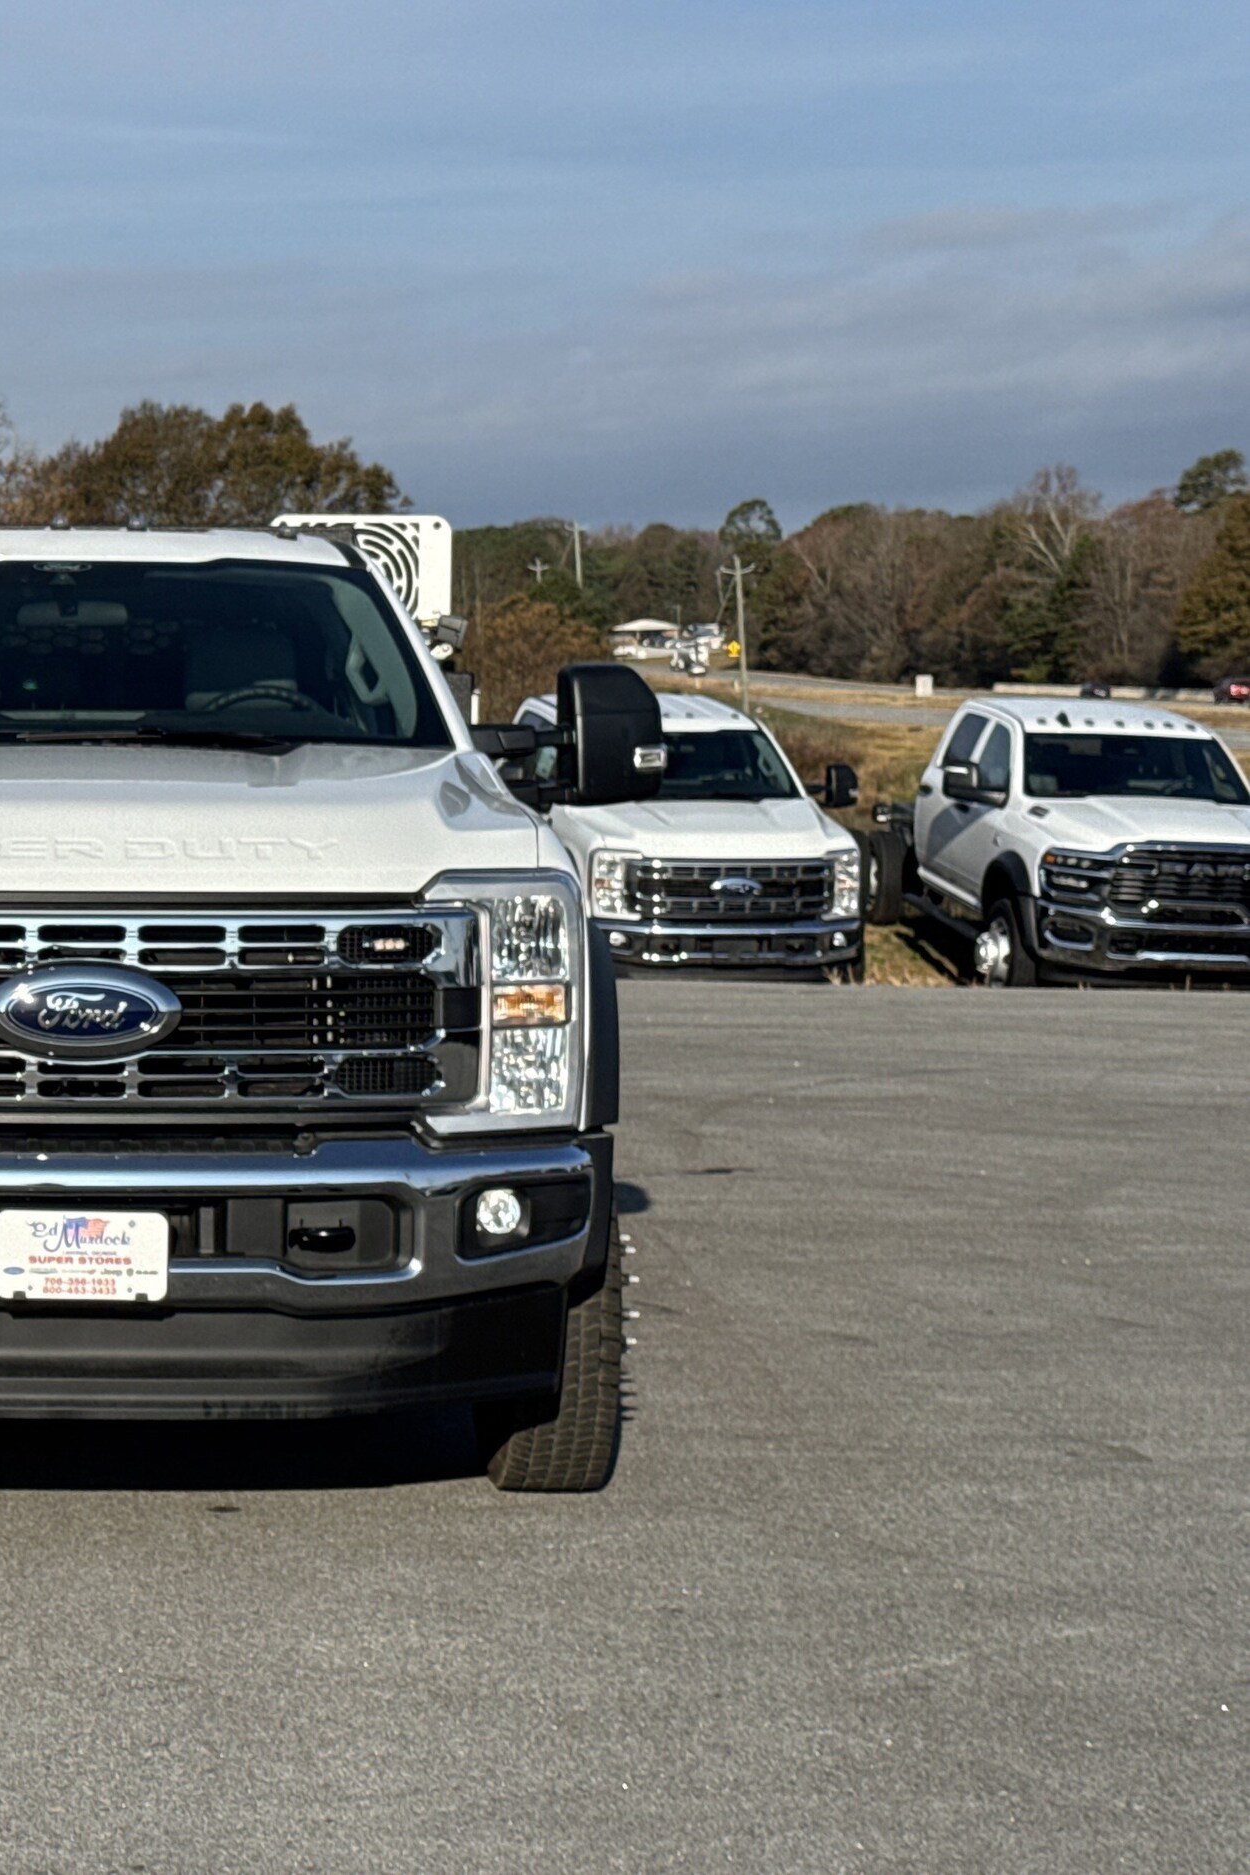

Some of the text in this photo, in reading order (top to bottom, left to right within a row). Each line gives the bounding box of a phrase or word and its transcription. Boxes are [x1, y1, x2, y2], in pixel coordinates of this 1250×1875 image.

[124, 836, 340, 861] DUTY
[37, 991, 128, 1030] Ford
[26, 1220, 131, 1253] Ed Murdock
[28, 1256, 132, 1265] SUPER STORES
